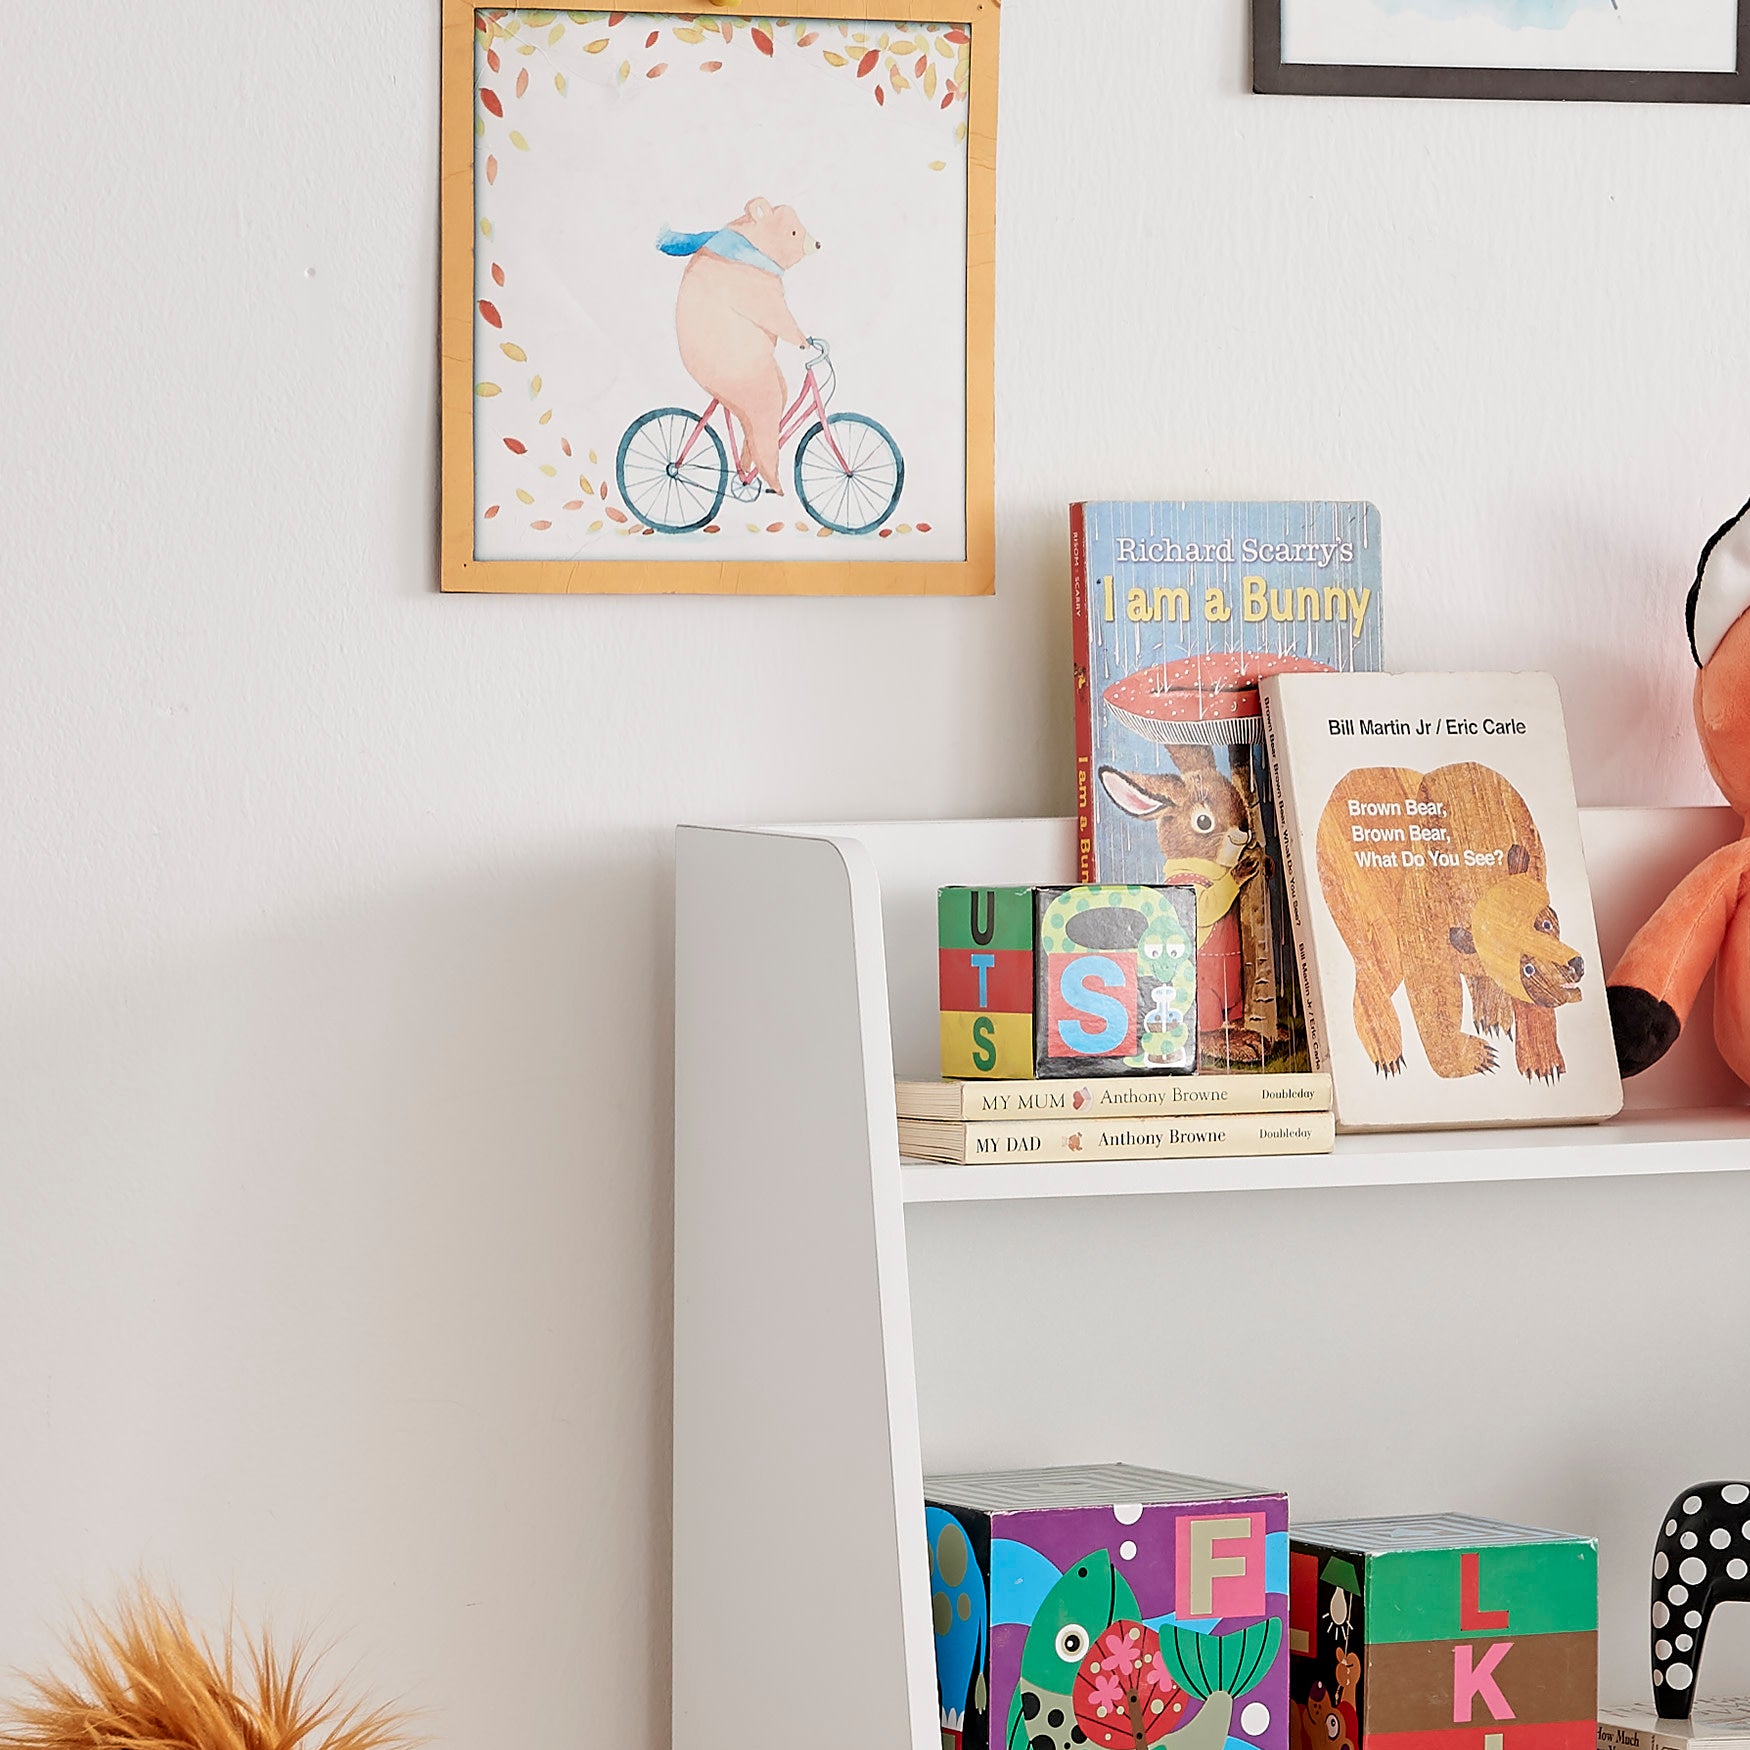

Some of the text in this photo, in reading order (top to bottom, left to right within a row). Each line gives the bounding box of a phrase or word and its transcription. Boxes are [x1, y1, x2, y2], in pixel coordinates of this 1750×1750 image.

[1116, 536, 1354, 568] Richard Scarry's
[1103, 575, 1372, 638] I am a Bunny
[1263, 696, 1273, 735] Brown
[1328, 718, 1527, 737] Bill Martin Jr / Eric Carle
[1079, 770, 1087, 808] am
[1273, 763, 1282, 800] Brown
[1080, 815, 1088, 832] a
[1348, 799, 1447, 818] Brown Bear,
[1283, 828, 1292, 858] What
[1352, 825, 1451, 844] Brown Bear,
[1287, 858, 1294, 877] Do
[1355, 848, 1504, 868] What Do You See?
[971, 891, 995, 946] U
[1293, 900, 1301, 926] See?
[971, 953, 996, 1009] T
[1302, 961, 1310, 997] Martin
[1058, 954, 1130, 1055] S
[972, 1016, 996, 1072] S
[1309, 1017, 1317, 1040] Eric
[1313, 1041, 1321, 1071] Carle
[981, 1085, 1316, 1111] MY MUM Anthony Browne Doubleday
[975, 1127, 1313, 1154] MY DAD Anthony Browne Doubleday
[1189, 1518, 1252, 1616] F
[1460, 1553, 1510, 1632] L
[1452, 1641, 1516, 1724] K
[1616, 1729, 1640, 1747] Much
